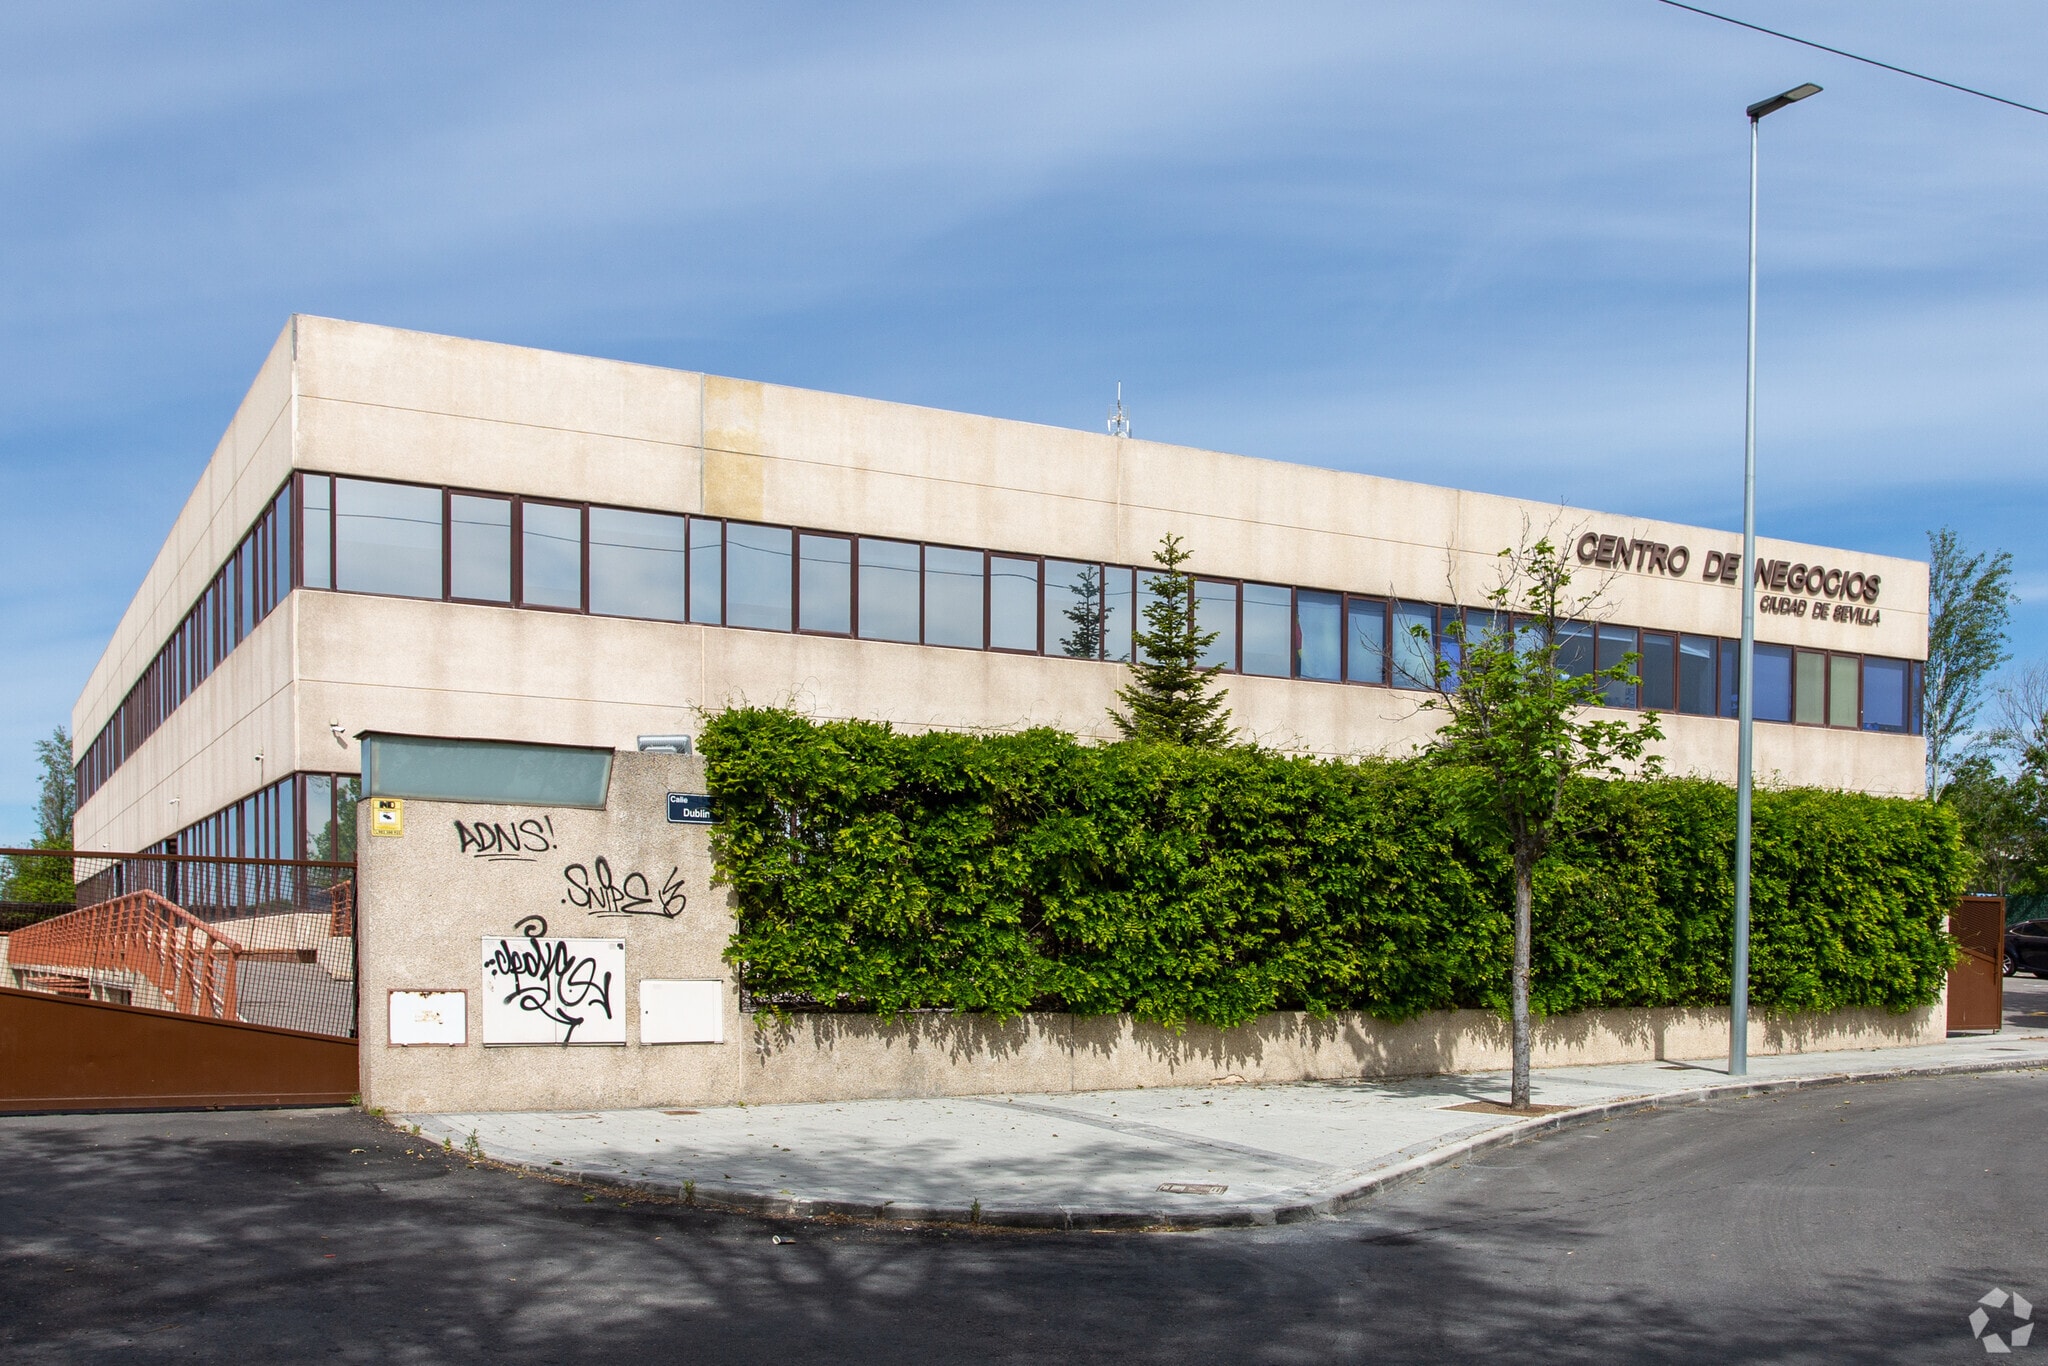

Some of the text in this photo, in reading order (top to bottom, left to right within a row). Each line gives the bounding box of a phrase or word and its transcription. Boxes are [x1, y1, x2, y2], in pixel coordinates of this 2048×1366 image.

[1577, 532, 1881, 602] CENTRO DE NEGOCIOS
[1760, 595, 1881, 627] CIUDAD DE SEVILLA
[670, 795, 689, 804] Calle
[683, 808, 711, 819] Dublin
